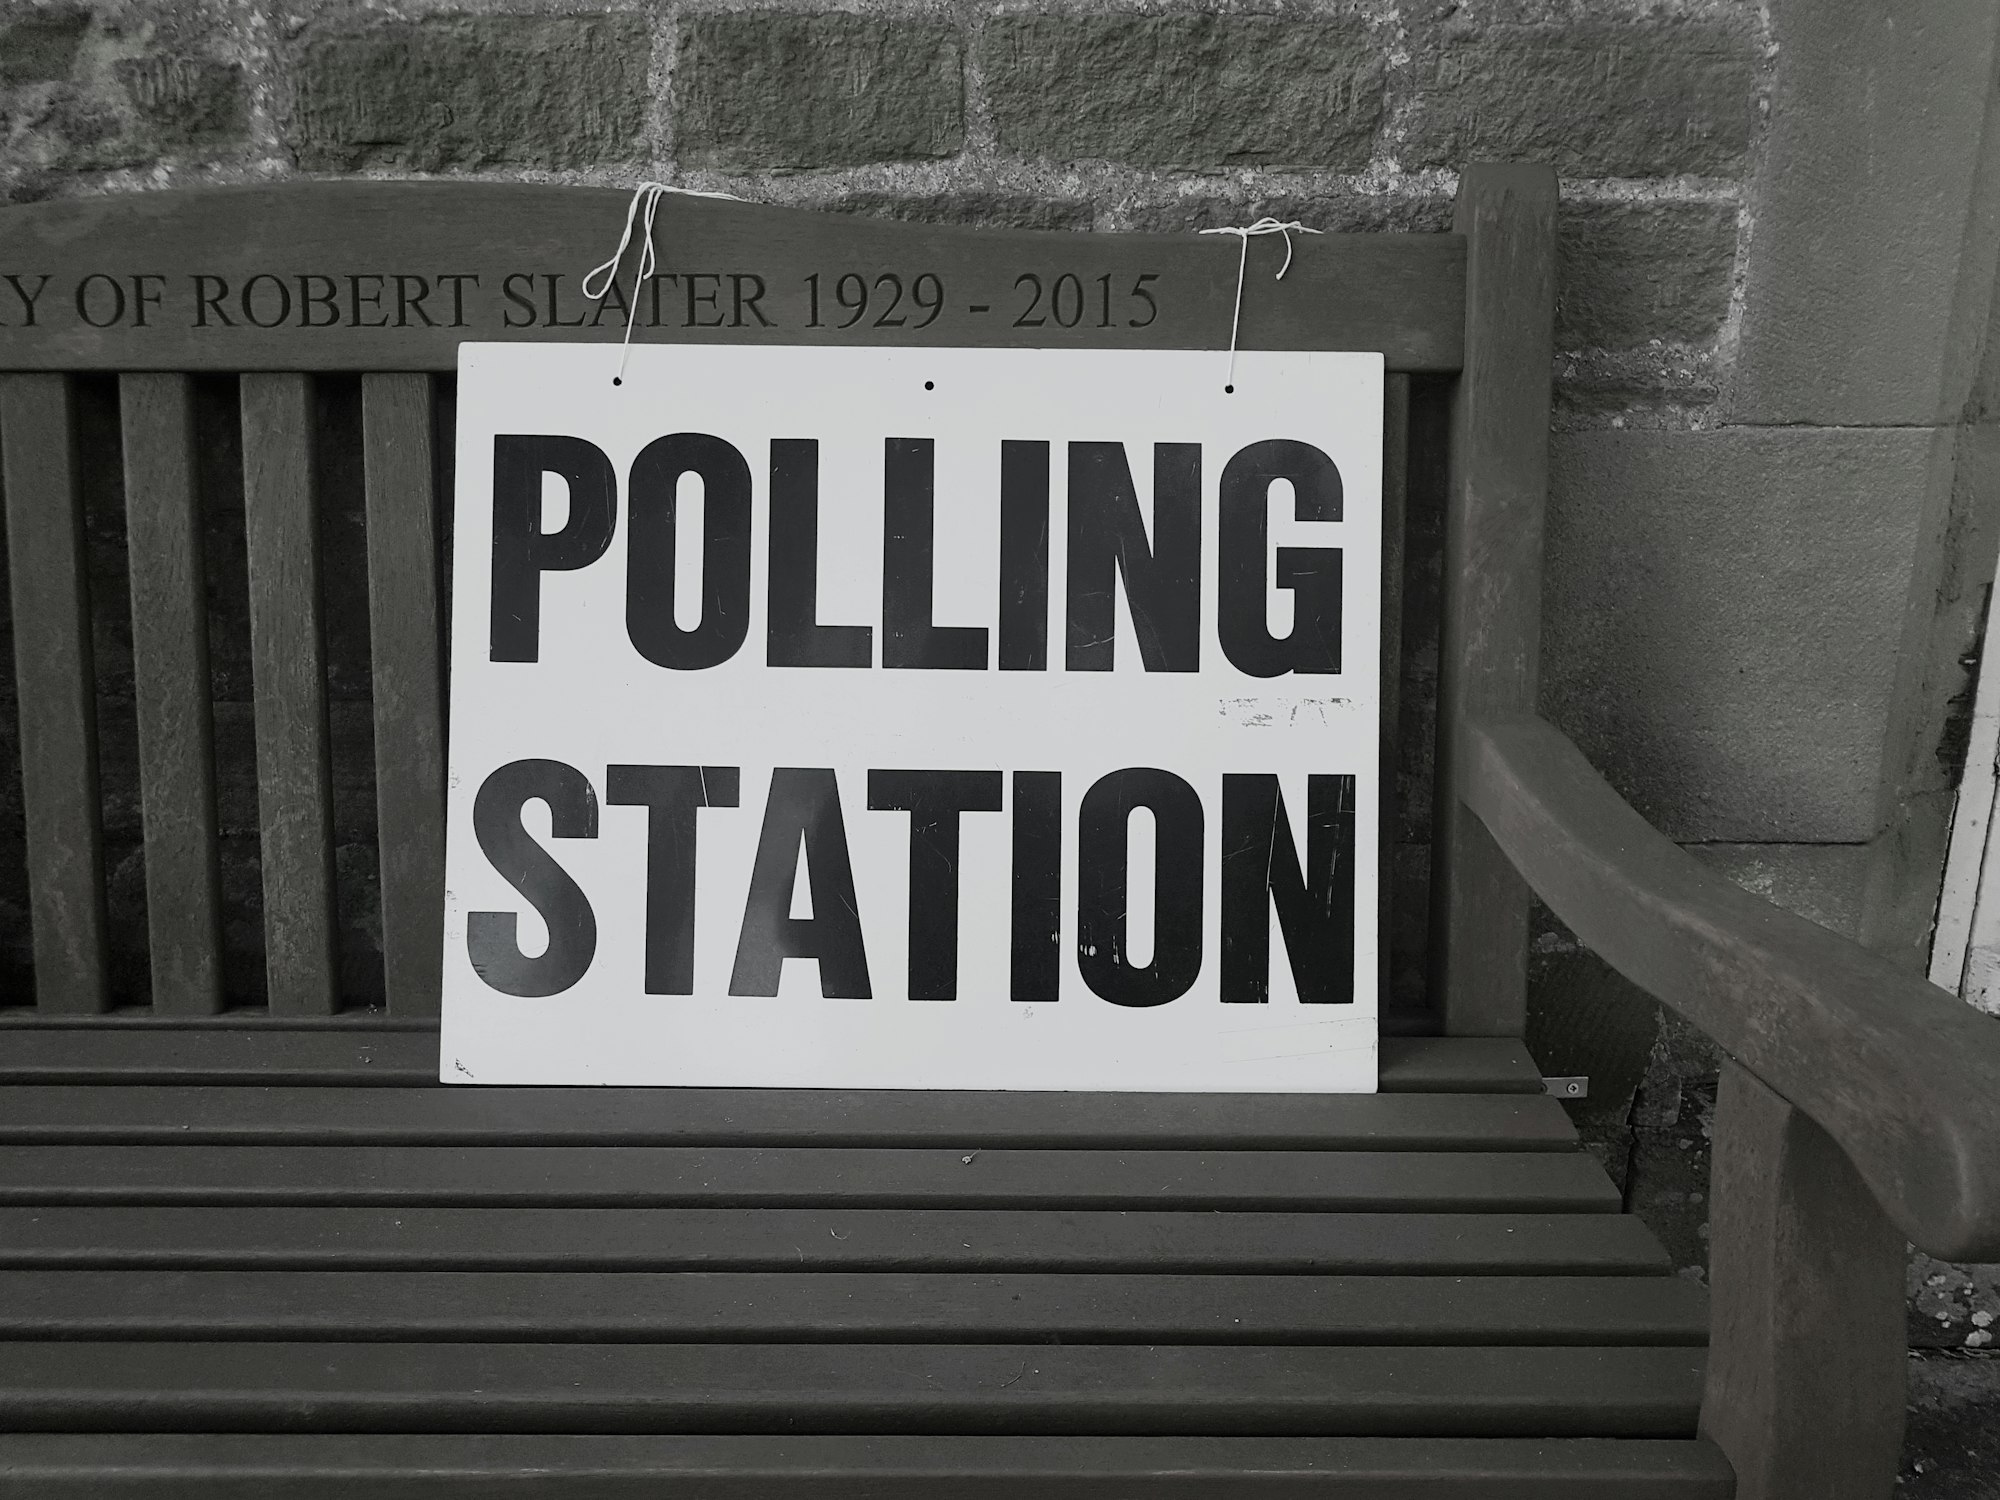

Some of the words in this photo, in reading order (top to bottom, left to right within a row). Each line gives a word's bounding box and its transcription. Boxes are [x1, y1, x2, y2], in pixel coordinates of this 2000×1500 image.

[0, 274, 54, 327] Y
[74, 273, 167, 328] OF
[189, 273, 480, 328] ROBERT
[502, 272, 777, 328] SLATER
[803, 272, 945, 328] 1929
[1012, 273, 1160, 328] 2015
[490, 433, 1343, 677] POLLING
[466, 759, 1355, 1007] STATION
